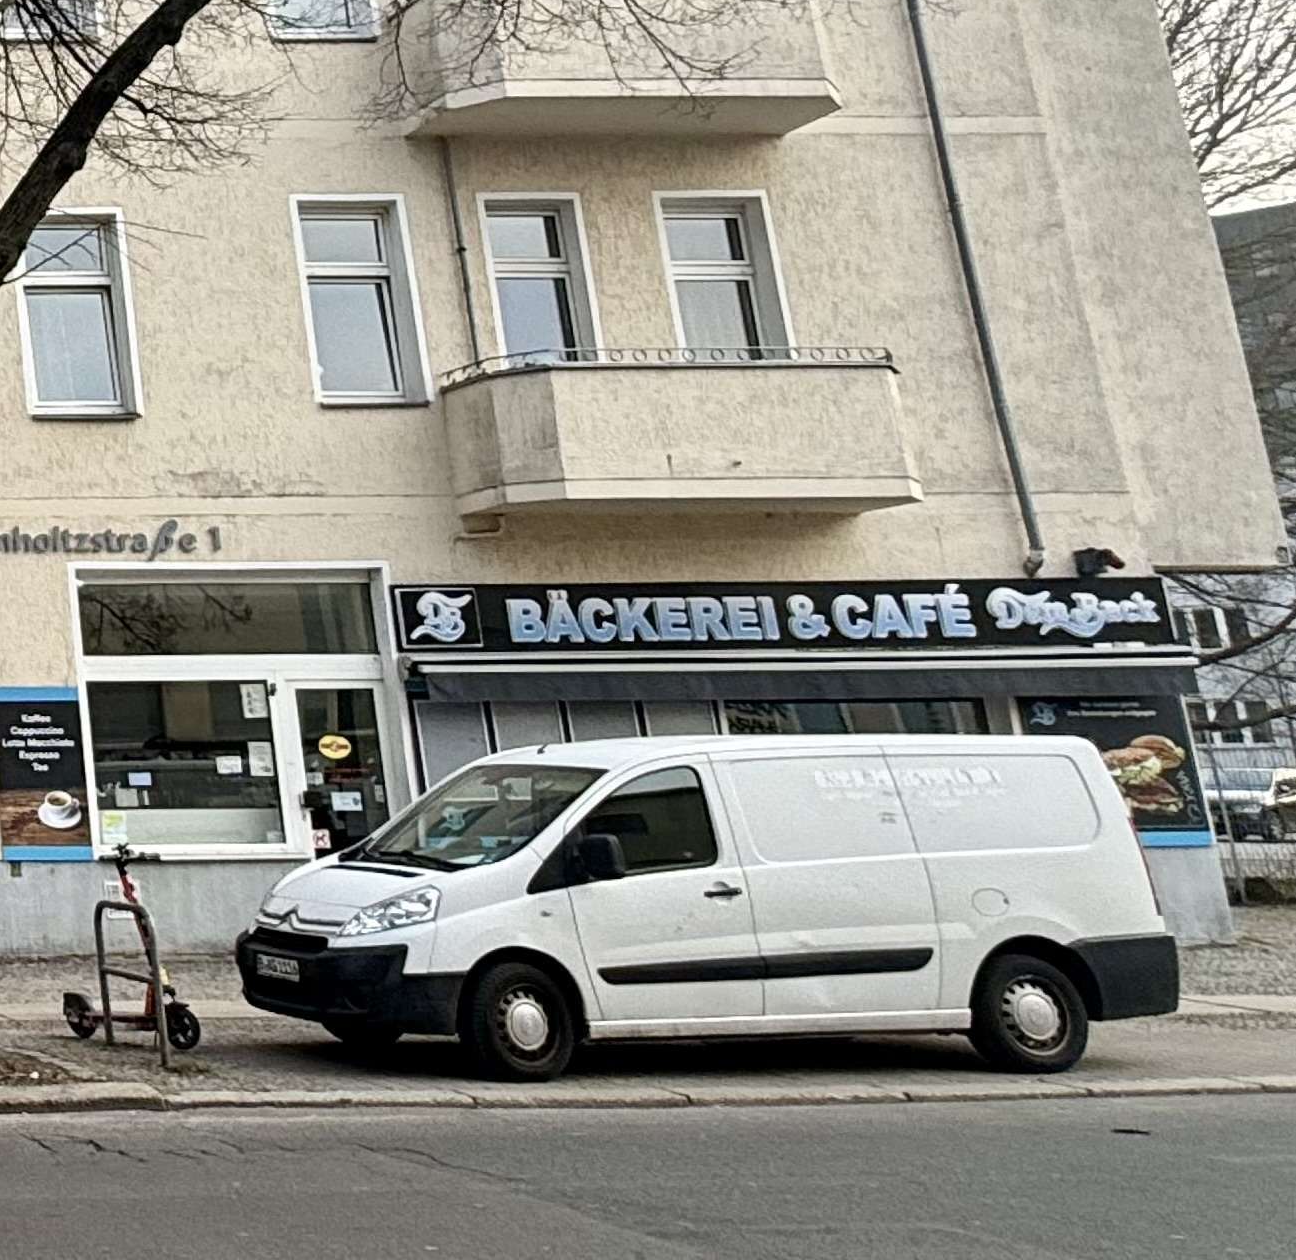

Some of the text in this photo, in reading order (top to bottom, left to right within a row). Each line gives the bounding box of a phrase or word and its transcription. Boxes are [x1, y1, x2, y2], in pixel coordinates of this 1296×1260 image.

[206, 526, 222, 553] 1
[505, 583, 978, 643] BÄCKEREI & CAFÉ
